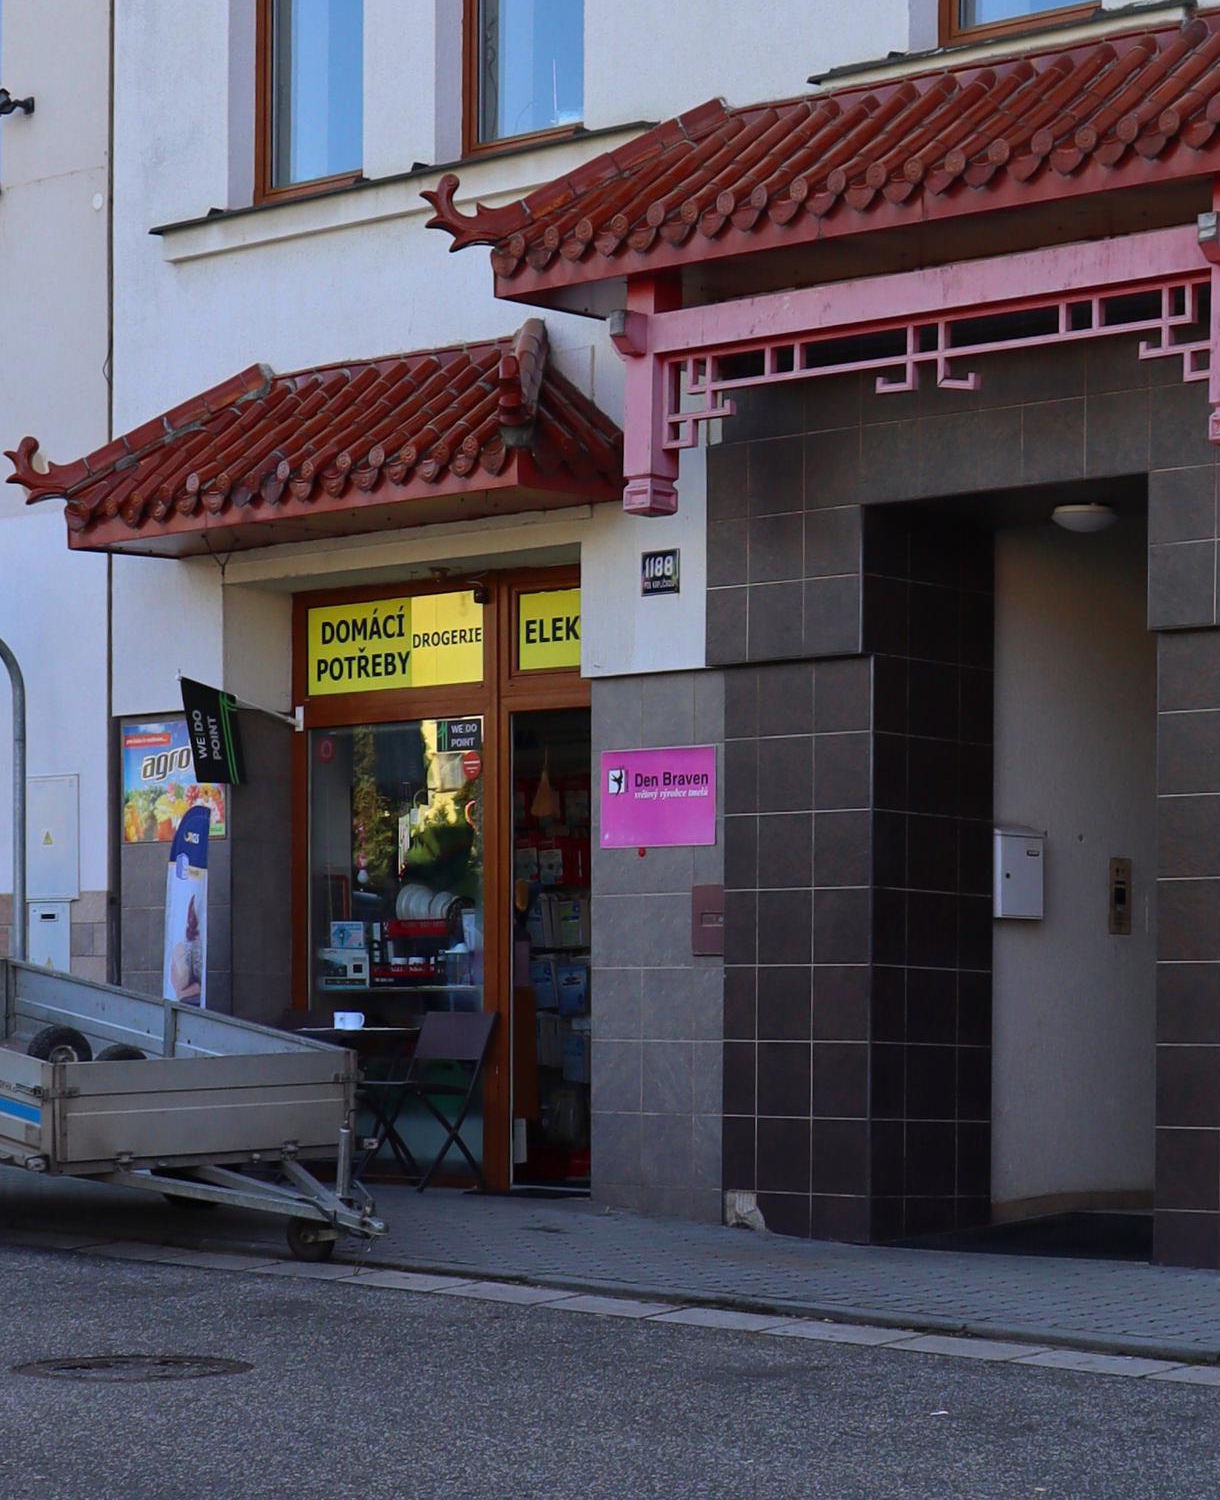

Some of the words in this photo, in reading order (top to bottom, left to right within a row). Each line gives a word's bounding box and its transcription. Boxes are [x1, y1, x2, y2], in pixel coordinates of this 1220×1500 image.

[645, 556, 674, 578] 1188
[321, 606, 405, 645] DOMÁCÍ
[412, 627, 482, 649] DROGERIE
[317, 648, 411, 682] POTŘEBY
[207, 715, 222, 760] POINT
[451, 724, 463, 733] WE
[465, 723, 477, 732] DO
[451, 737, 475, 747] POINT
[634, 773, 658, 787] Den
[663, 772, 709, 786] Braven
